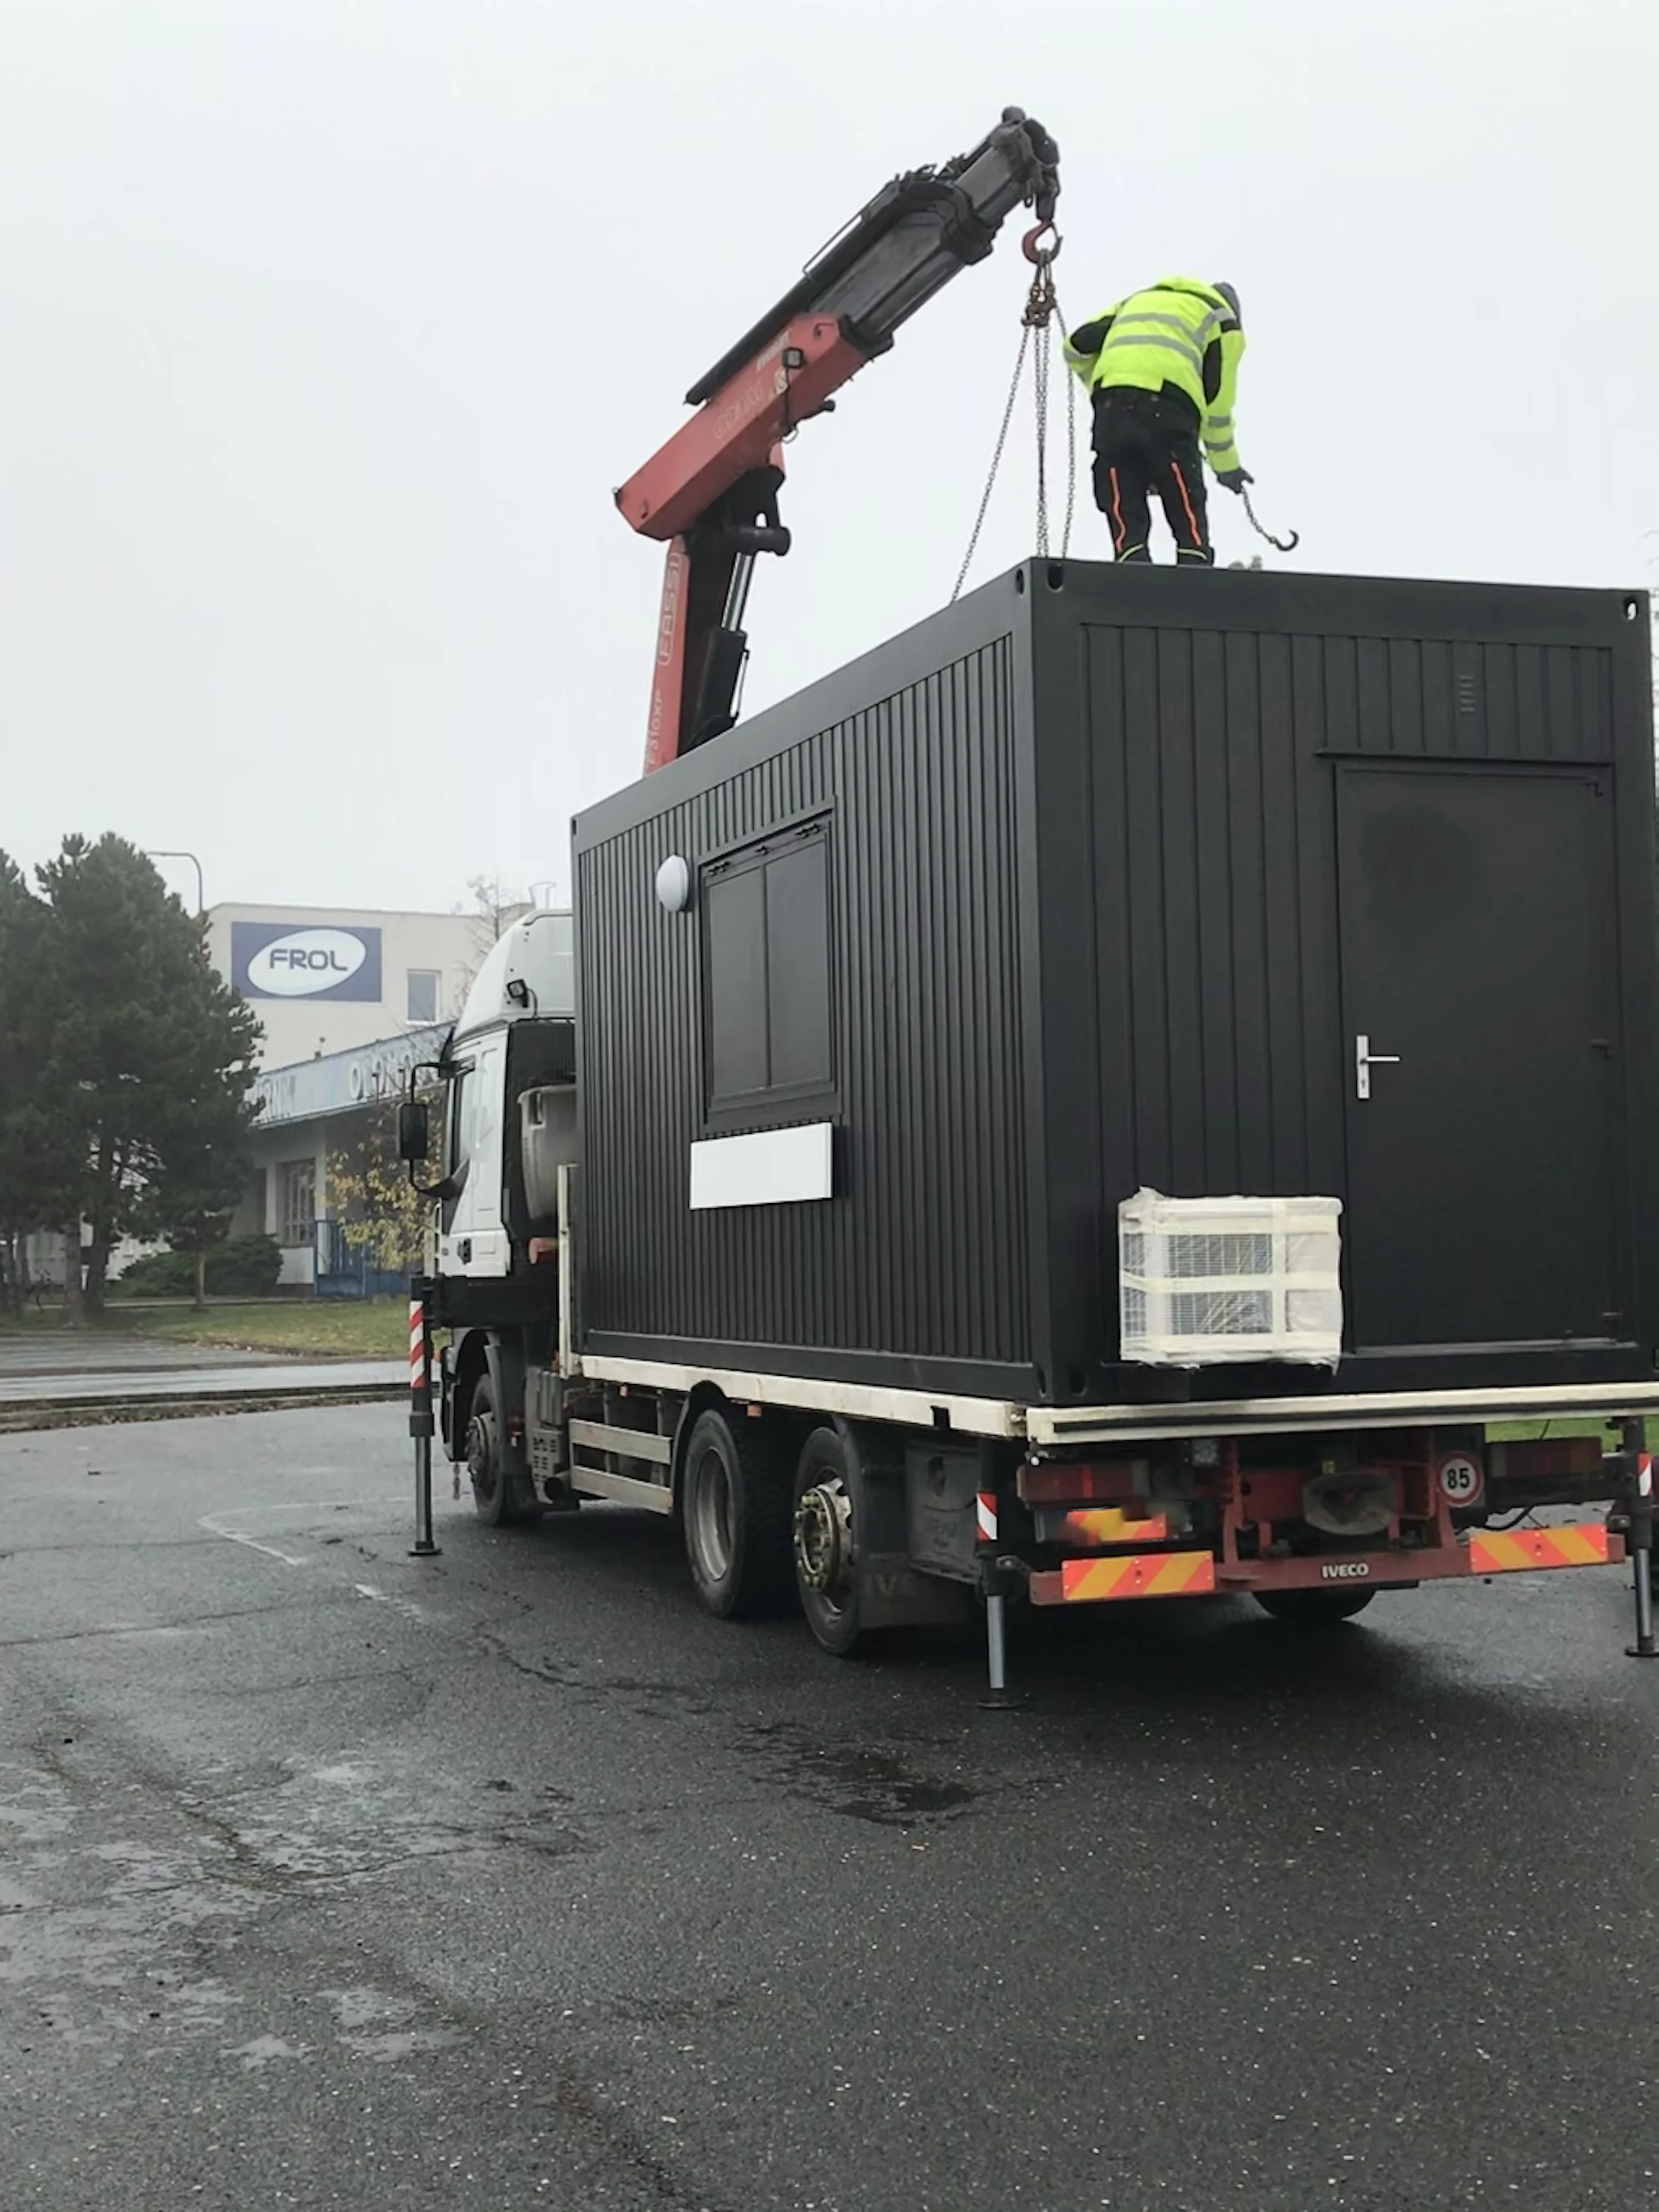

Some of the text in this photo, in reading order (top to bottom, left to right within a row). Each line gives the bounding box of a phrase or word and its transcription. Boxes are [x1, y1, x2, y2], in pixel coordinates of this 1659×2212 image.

[660, 561, 680, 658] FASSI
[269, 949, 348, 972] FROL
[1447, 1468, 1470, 1489] 85
[1322, 1563, 1369, 1579] IVECO
